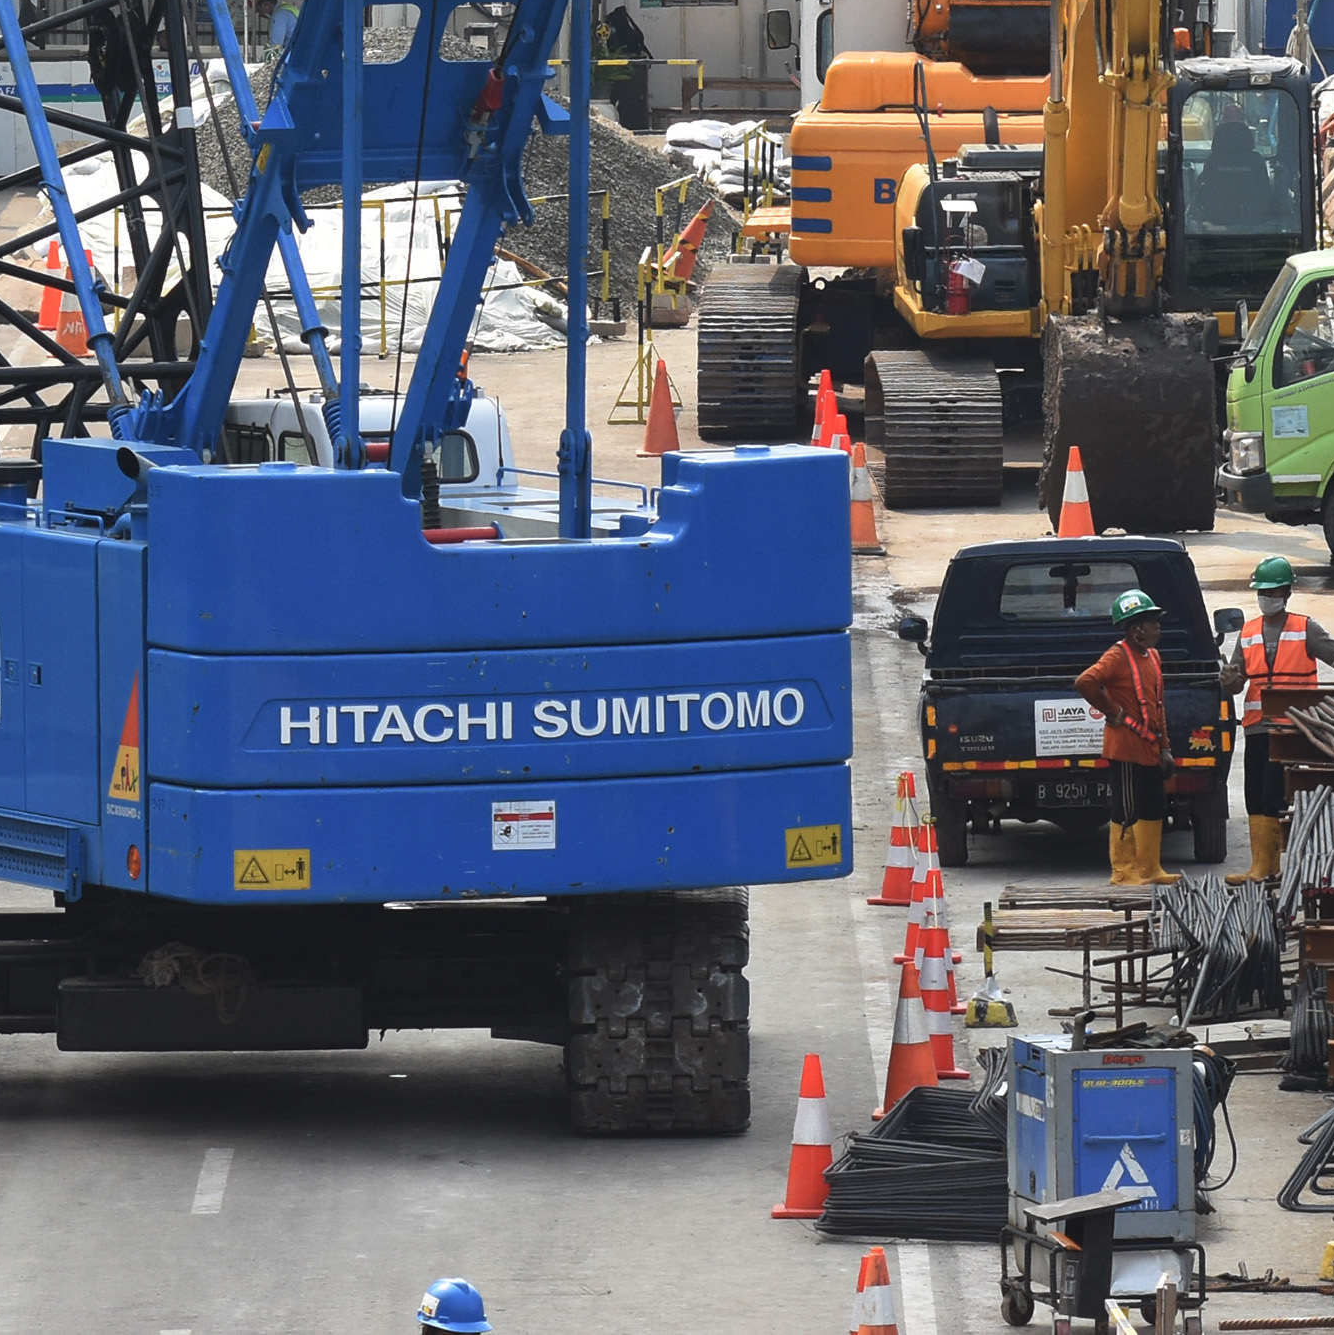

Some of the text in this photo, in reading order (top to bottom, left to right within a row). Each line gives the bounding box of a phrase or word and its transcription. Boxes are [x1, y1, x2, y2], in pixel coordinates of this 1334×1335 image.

[279, 687, 805, 745] HITACHI SUMITOMO
[1058, 707, 1086, 716] JAYA
[1038, 784, 1046, 799] B
[1056, 783, 1087, 798] 9250
[1103, 1054, 1145, 1066] Denyo
